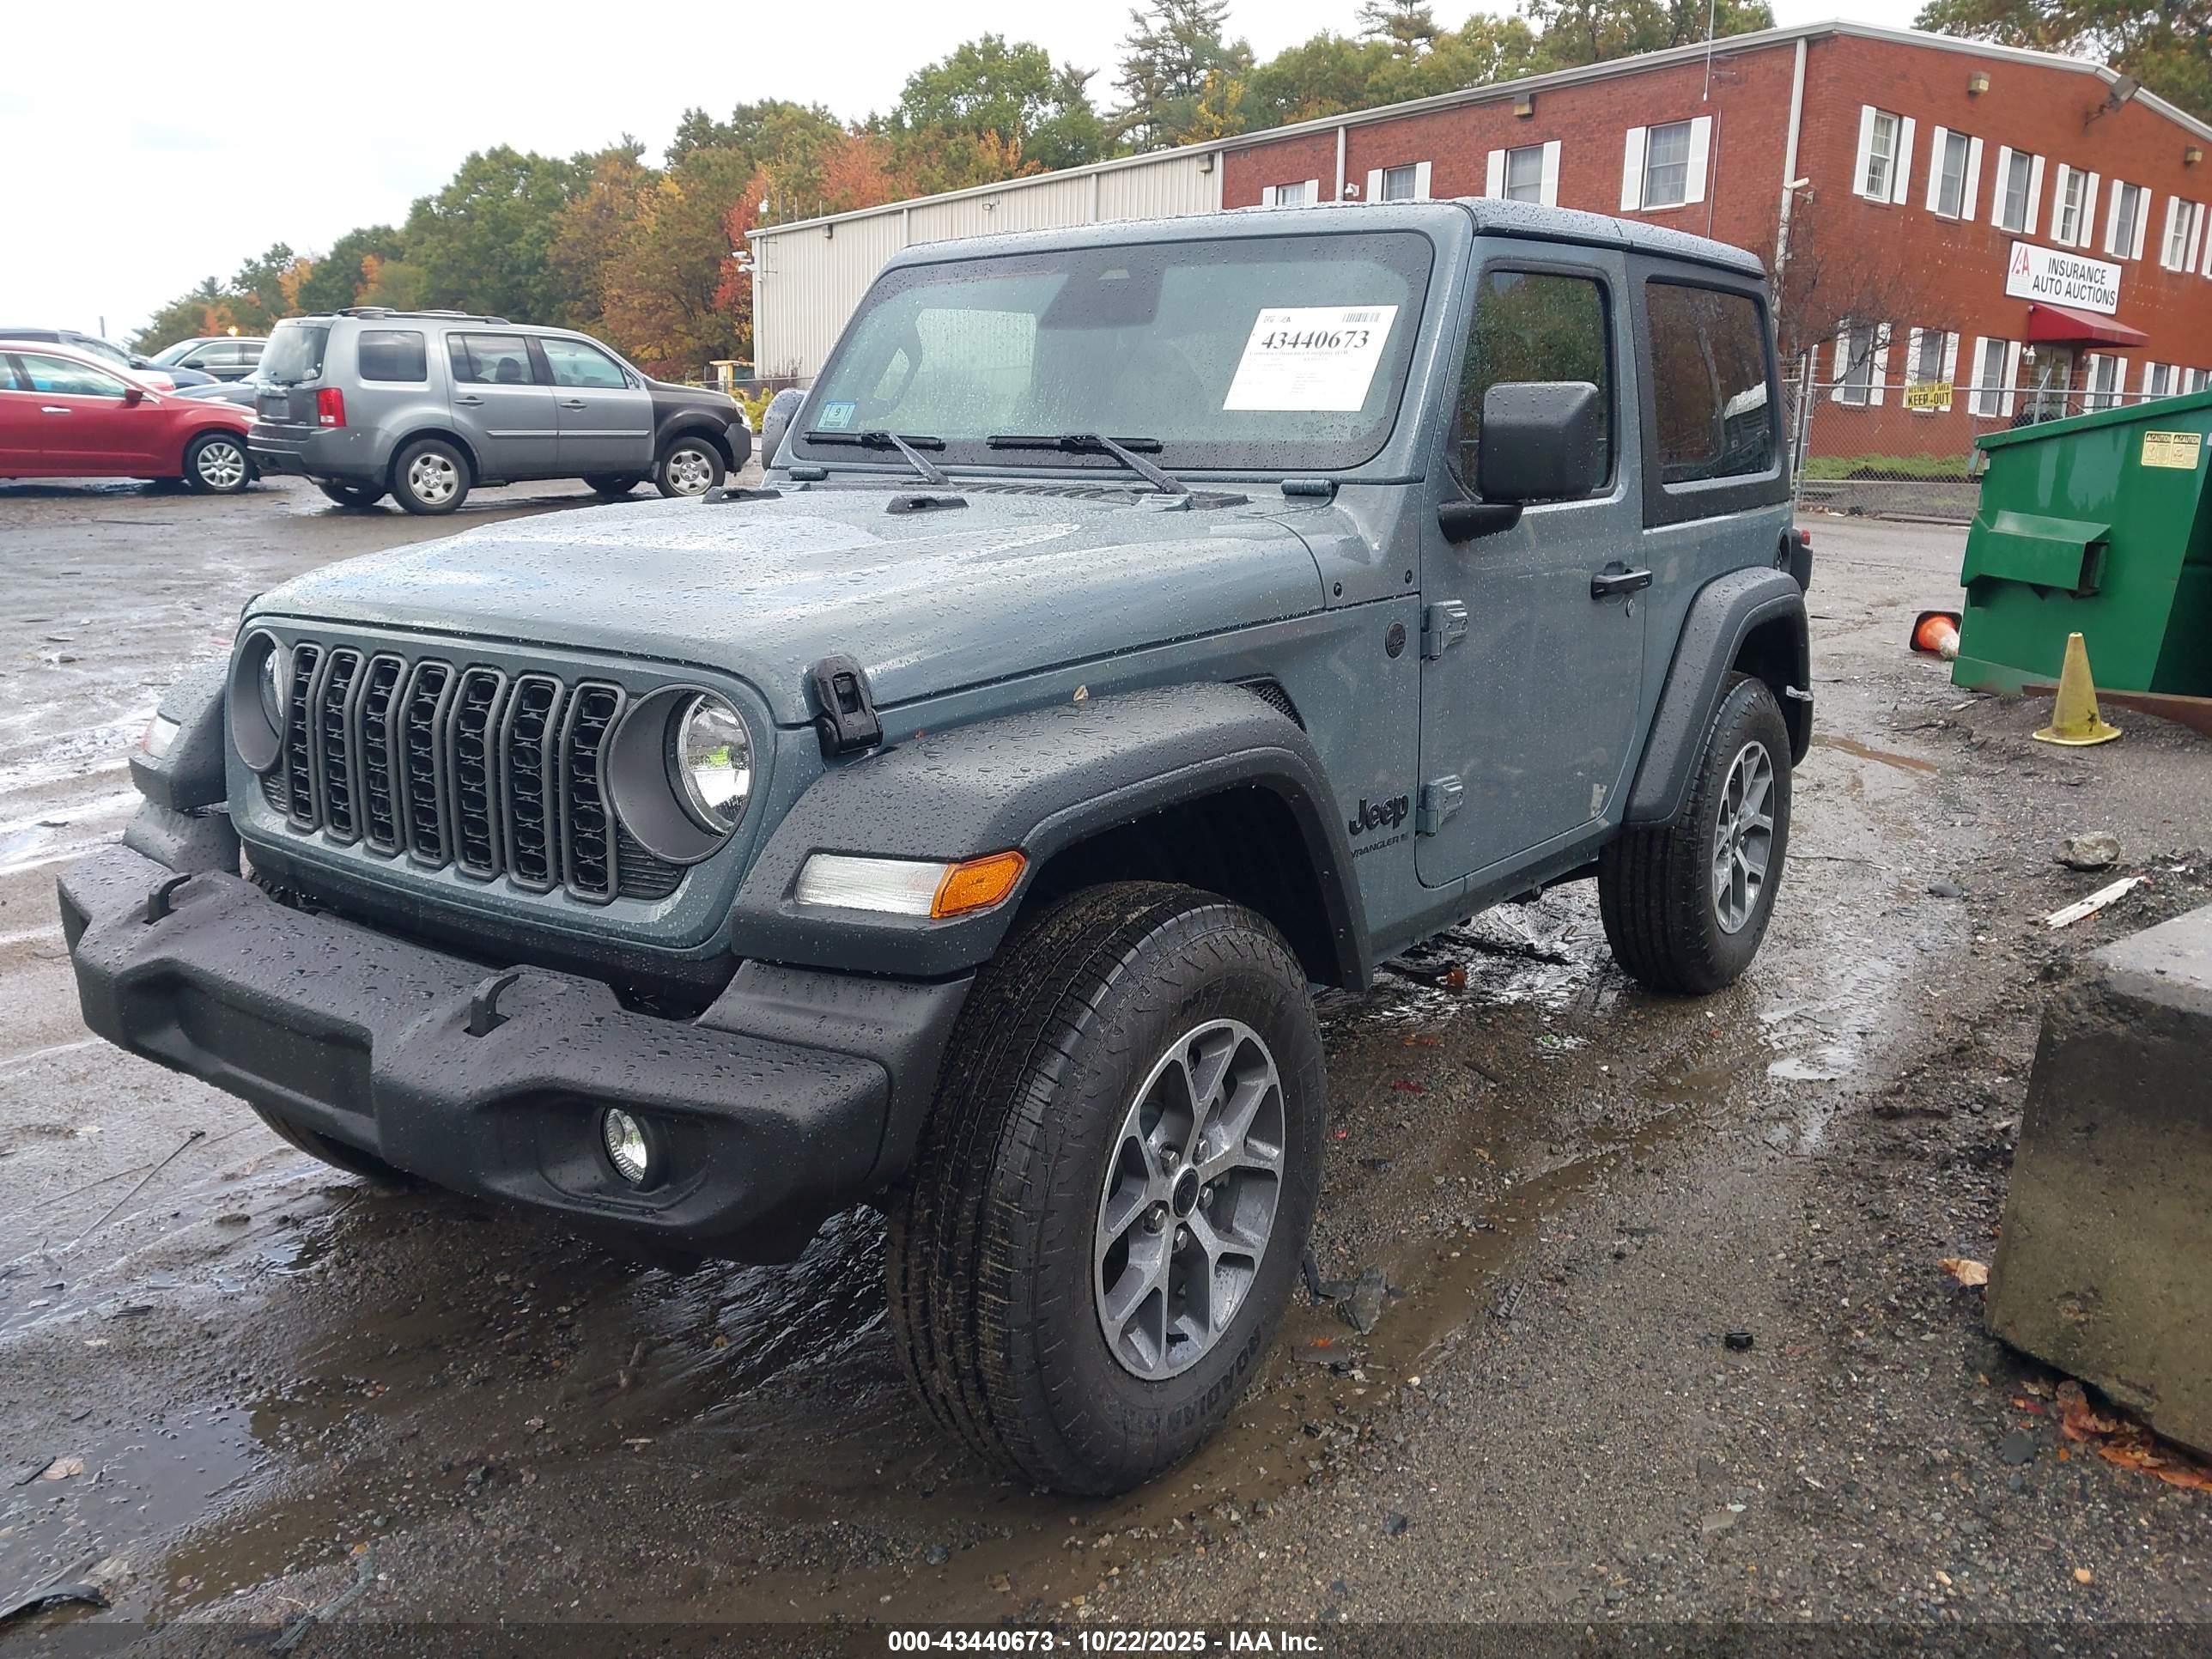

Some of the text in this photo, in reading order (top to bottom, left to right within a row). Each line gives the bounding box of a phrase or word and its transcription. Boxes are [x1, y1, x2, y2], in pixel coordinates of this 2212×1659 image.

[2048, 257, 2107, 285] INSURANCE
[2032, 275, 2116, 307] AUTO AUCTIONS
[1261, 330, 1370, 349] 43440673
[1908, 385, 1936, 393] RESTRICTED
[1908, 392, 1951, 406] KEEP OUT
[1349, 795, 1408, 836] Jeep
[1351, 836, 1400, 859] WRANGLER
